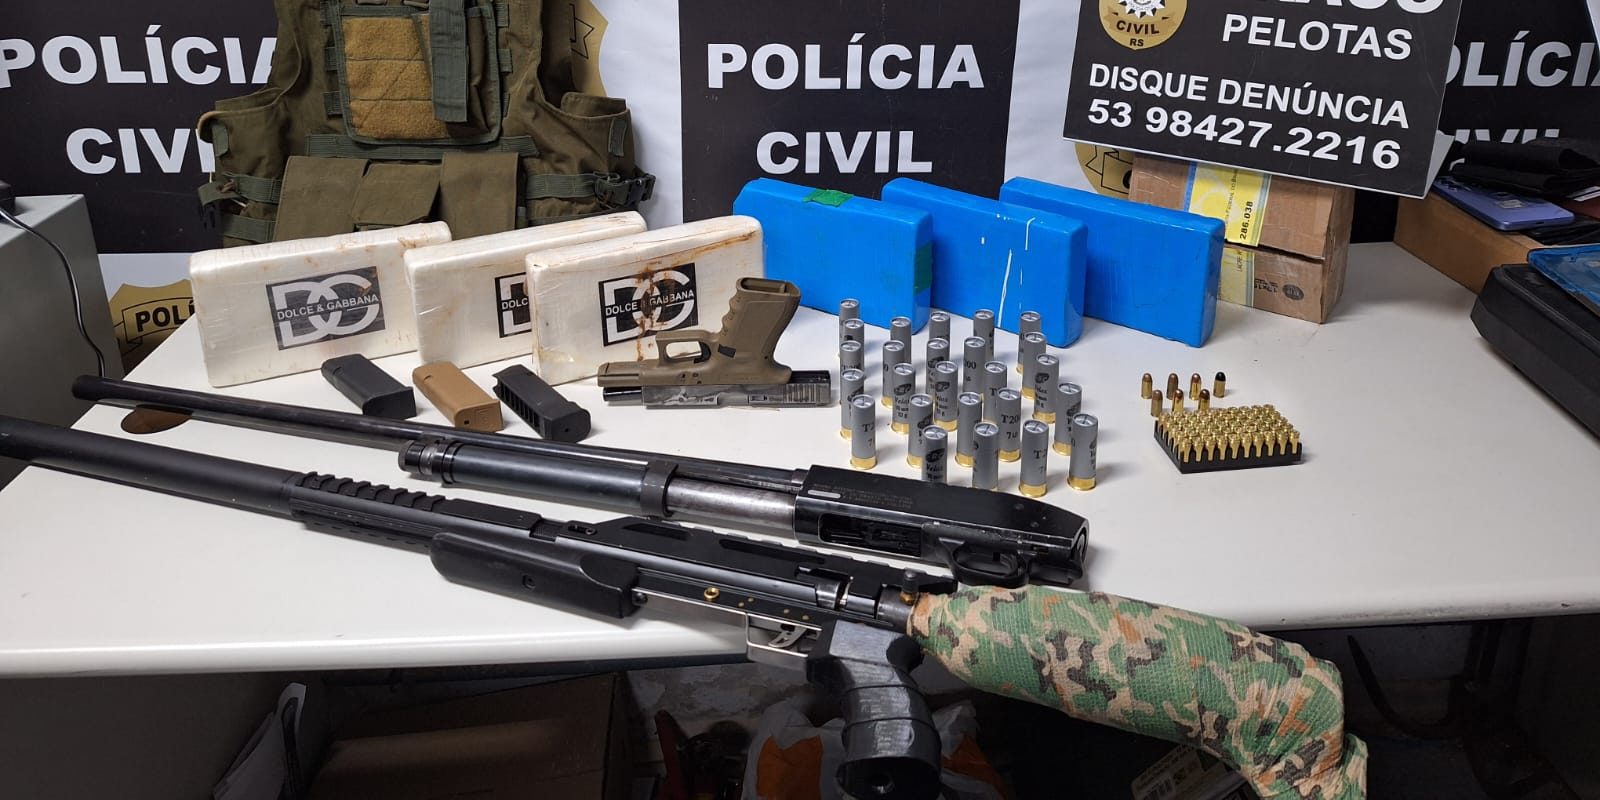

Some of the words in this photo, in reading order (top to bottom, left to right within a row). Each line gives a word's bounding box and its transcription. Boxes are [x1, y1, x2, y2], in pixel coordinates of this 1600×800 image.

[1116, 20, 1160, 35] CIVIL
[1129, 38, 1144, 47] RS
[1222, 13, 1413, 61] PELOTAS
[707, 33, 985, 90] POLÍCIA
[1446, 31, 1600, 87] LÍCI
[1089, 63, 1209, 101] DISQUE
[1217, 82, 1410, 129] DENÚNCIA
[756, 130, 933, 175] CIVIL
[1087, 99, 1133, 128] 53
[1145, 107, 1401, 170] 98427.2216
[1240, 201, 1253, 240] 286.038
[277, 305, 314, 320] DOLCE
[316, 303, 325, 312] &
[326, 294, 379, 311] GABBANA
[605, 303, 638, 316] DOLCE
